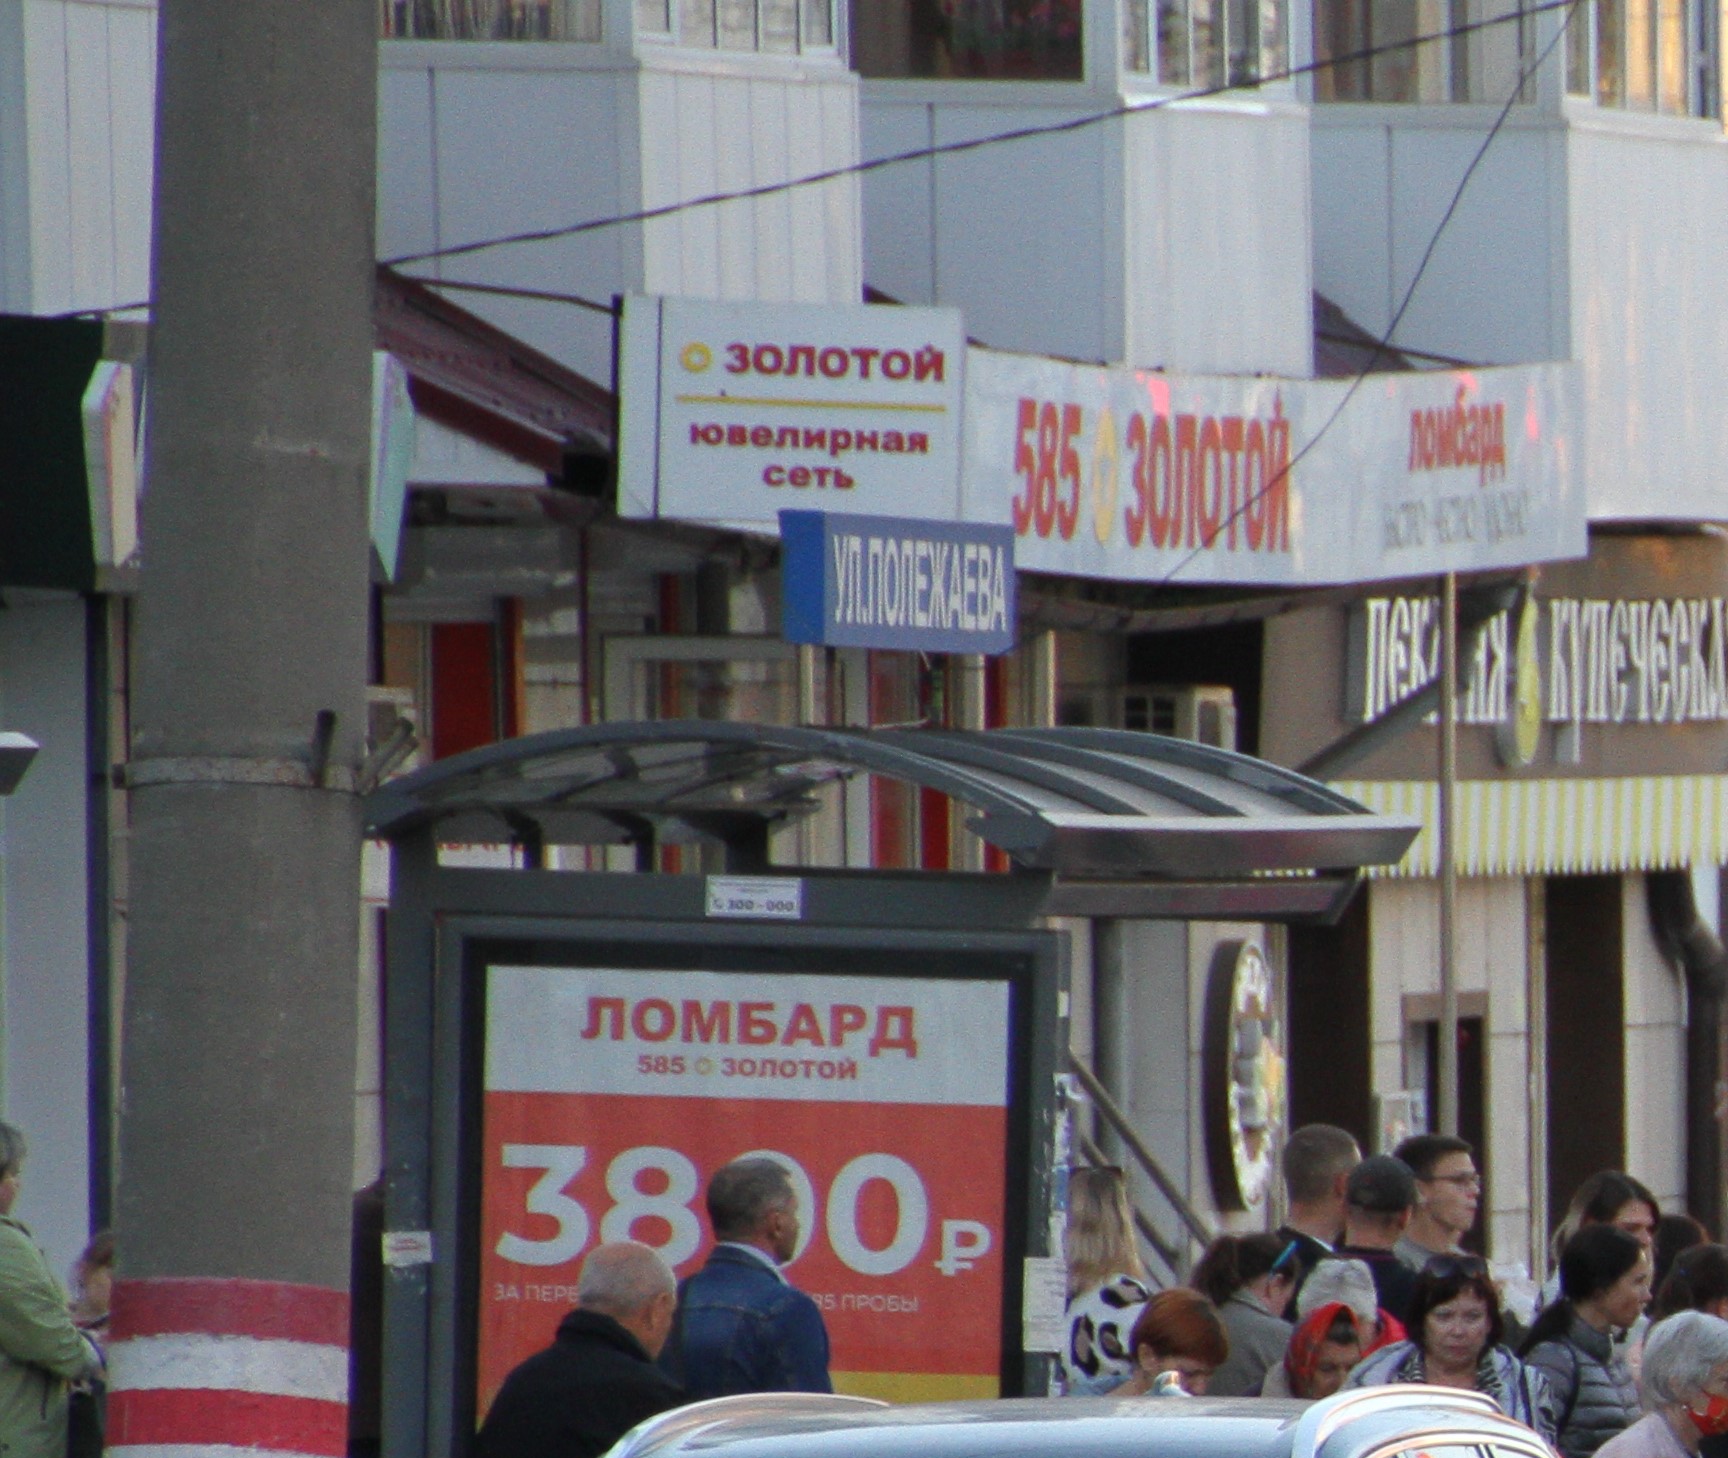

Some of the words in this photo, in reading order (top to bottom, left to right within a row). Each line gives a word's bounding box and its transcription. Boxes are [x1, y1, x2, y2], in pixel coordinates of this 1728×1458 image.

[725, 341, 945, 384] ЗОЛОТОЙ
[690, 420, 929, 456] ювелирная
[1408, 383, 1506, 487] ломбард
[762, 463, 856, 491] сеть
[1012, 397, 1083, 541] 585
[1124, 384, 1291, 553] ЗОЛОТОЙ
[580, 996, 919, 1059] ЛОМБАРД
[637, 1055, 686, 1076] 585
[494, 1283, 519, 1302] ЗА
[842, 1294, 919, 1313] ПРОБЫ
